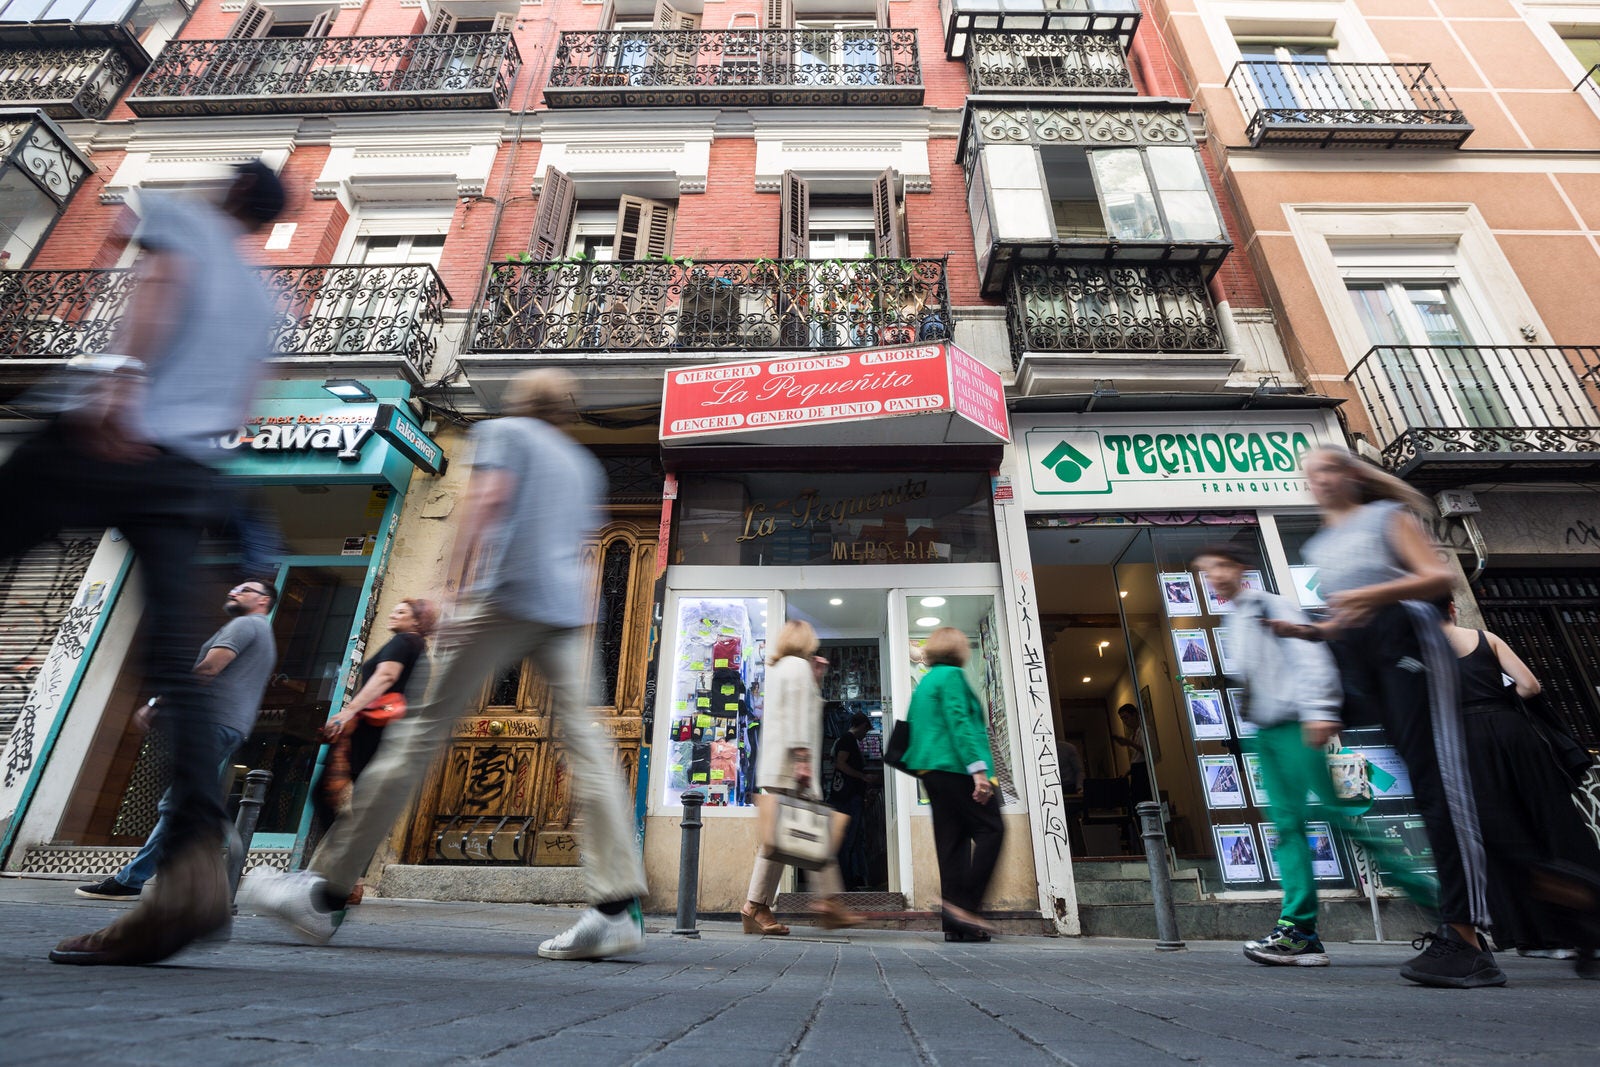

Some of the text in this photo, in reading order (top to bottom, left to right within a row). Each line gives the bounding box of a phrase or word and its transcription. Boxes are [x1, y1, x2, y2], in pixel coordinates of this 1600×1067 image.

[683, 347, 934, 383] MERCERIA BOTONES LABORES
[953, 348, 984, 377] MERCERIA
[701, 370, 914, 406] La Pequeñita
[954, 364, 999, 402] ROPA INTERIOR
[956, 381, 993, 412] CALCETINES
[266, 415, 295, 424] mex
[296, 413, 323, 424] food
[326, 414, 376, 425] compan
[676, 396, 939, 432] LENCERIA GENERO DE PUNTO PANTYS
[958, 397, 1005, 434] PIJAMAS FAJAS
[208, 424, 374, 458] o-away
[1104, 431, 1312, 475] TECNOCASA
[1202, 481, 1312, 493] FRANQUICIA
[735, 502, 777, 543] La
